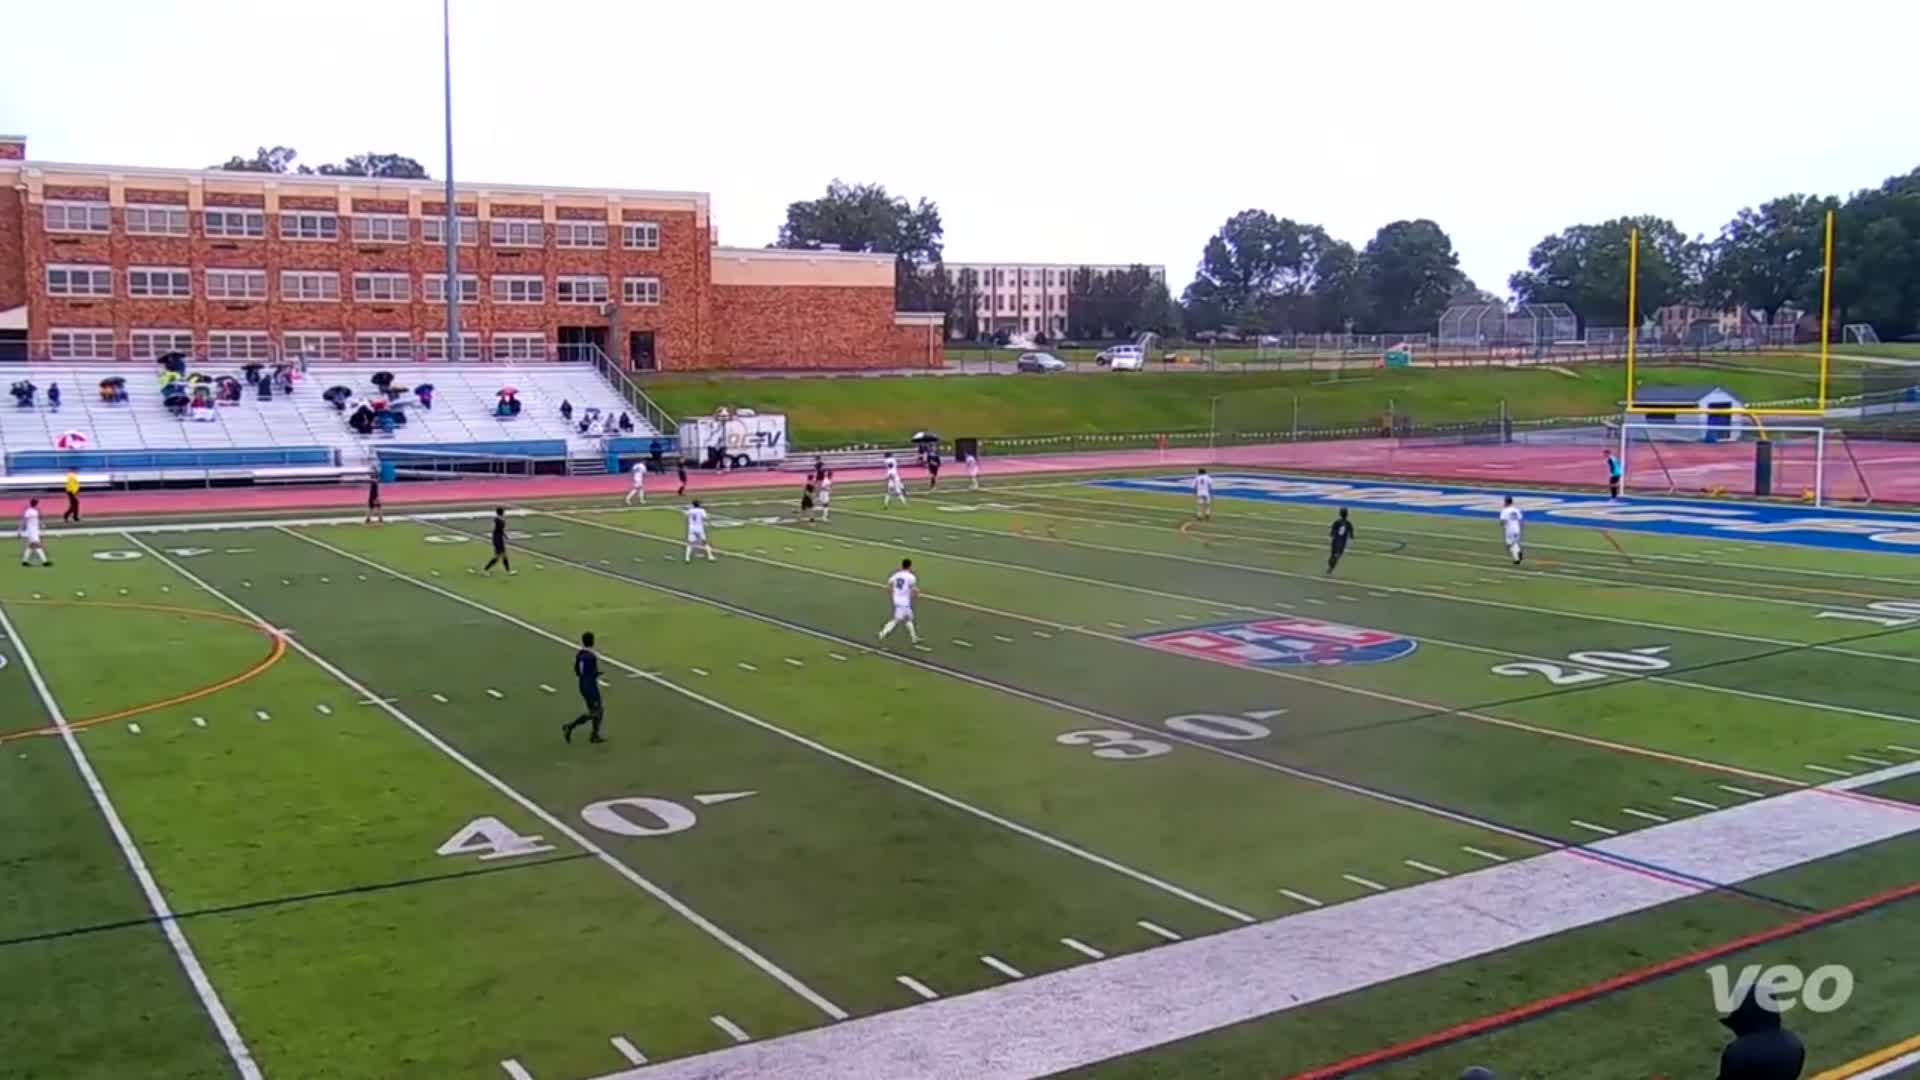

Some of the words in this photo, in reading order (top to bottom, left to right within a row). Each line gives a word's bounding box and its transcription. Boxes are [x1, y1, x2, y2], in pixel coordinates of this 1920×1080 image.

[1491, 650, 1670, 685] 20
[1056, 713, 1271, 759] 30
[437, 797, 696, 860] 40
